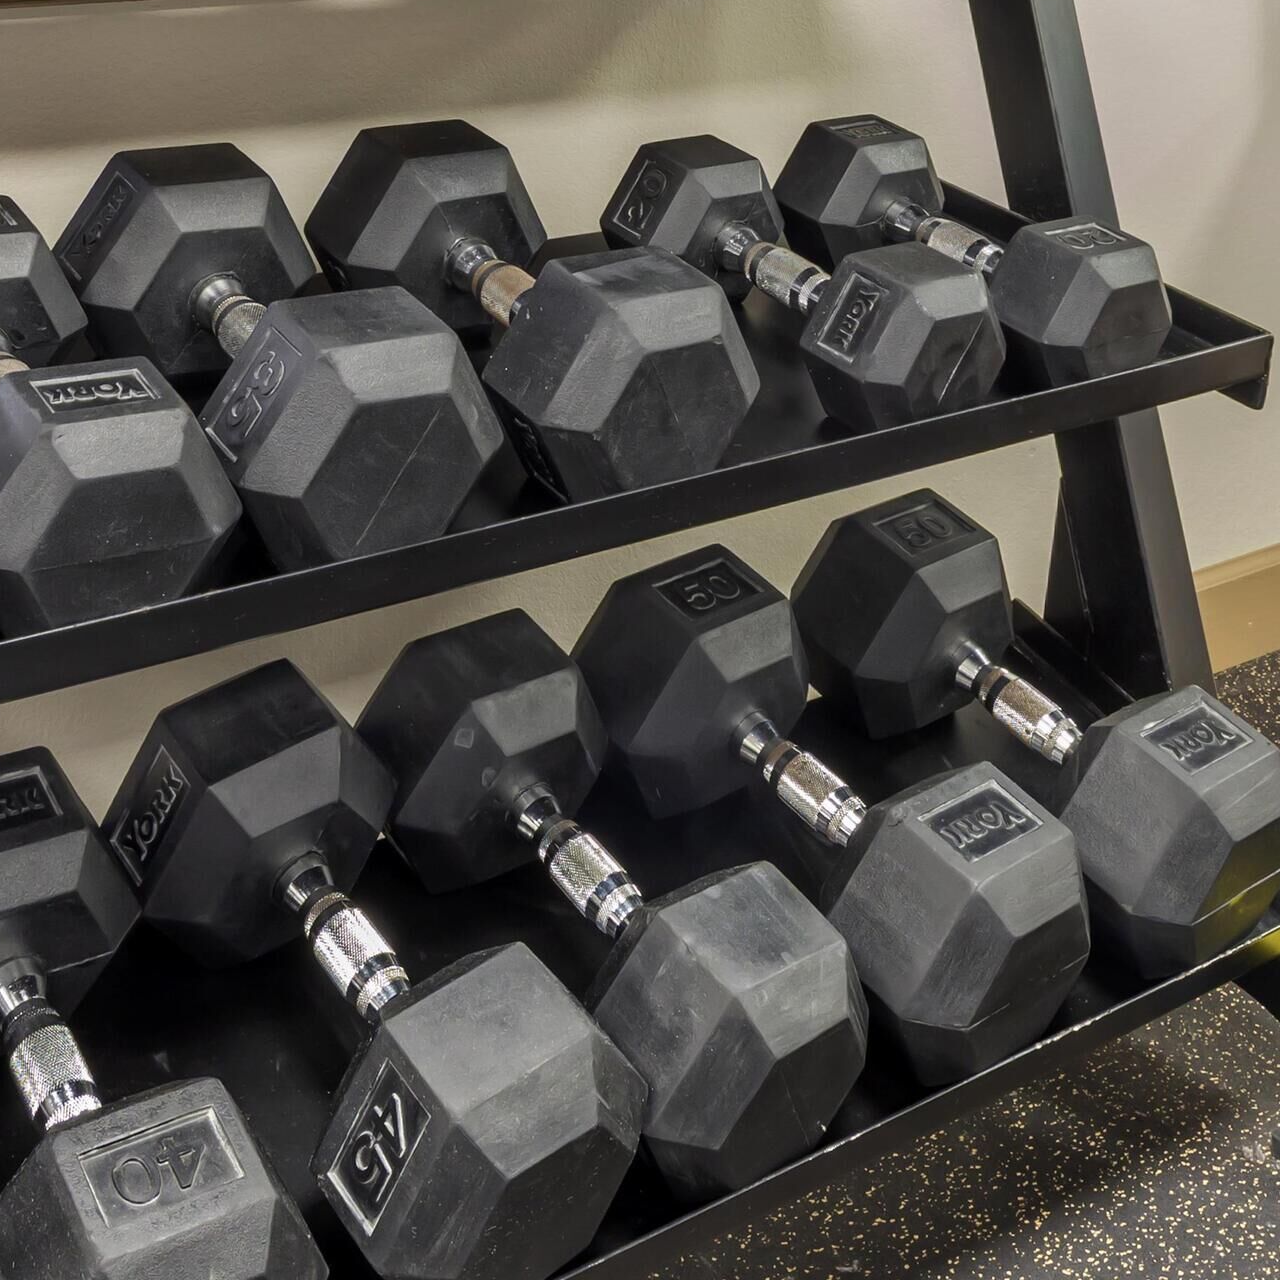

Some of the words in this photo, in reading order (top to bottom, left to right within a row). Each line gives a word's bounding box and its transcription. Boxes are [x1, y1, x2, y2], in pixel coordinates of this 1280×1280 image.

[627, 169, 669, 231] 20
[1056, 227, 1118, 250] 20
[840, 289, 880, 352] YORK
[43, 379, 152, 405] YORK
[229, 350, 285, 438] 35
[899, 515, 954, 549] 50
[686, 575, 741, 611] 50
[1160, 720, 1238, 762] YORK
[121, 766, 184, 861] YORK
[939, 799, 1027, 850] YORK
[111, 1136, 207, 1207] 40
[354, 1092, 407, 1202] 45
